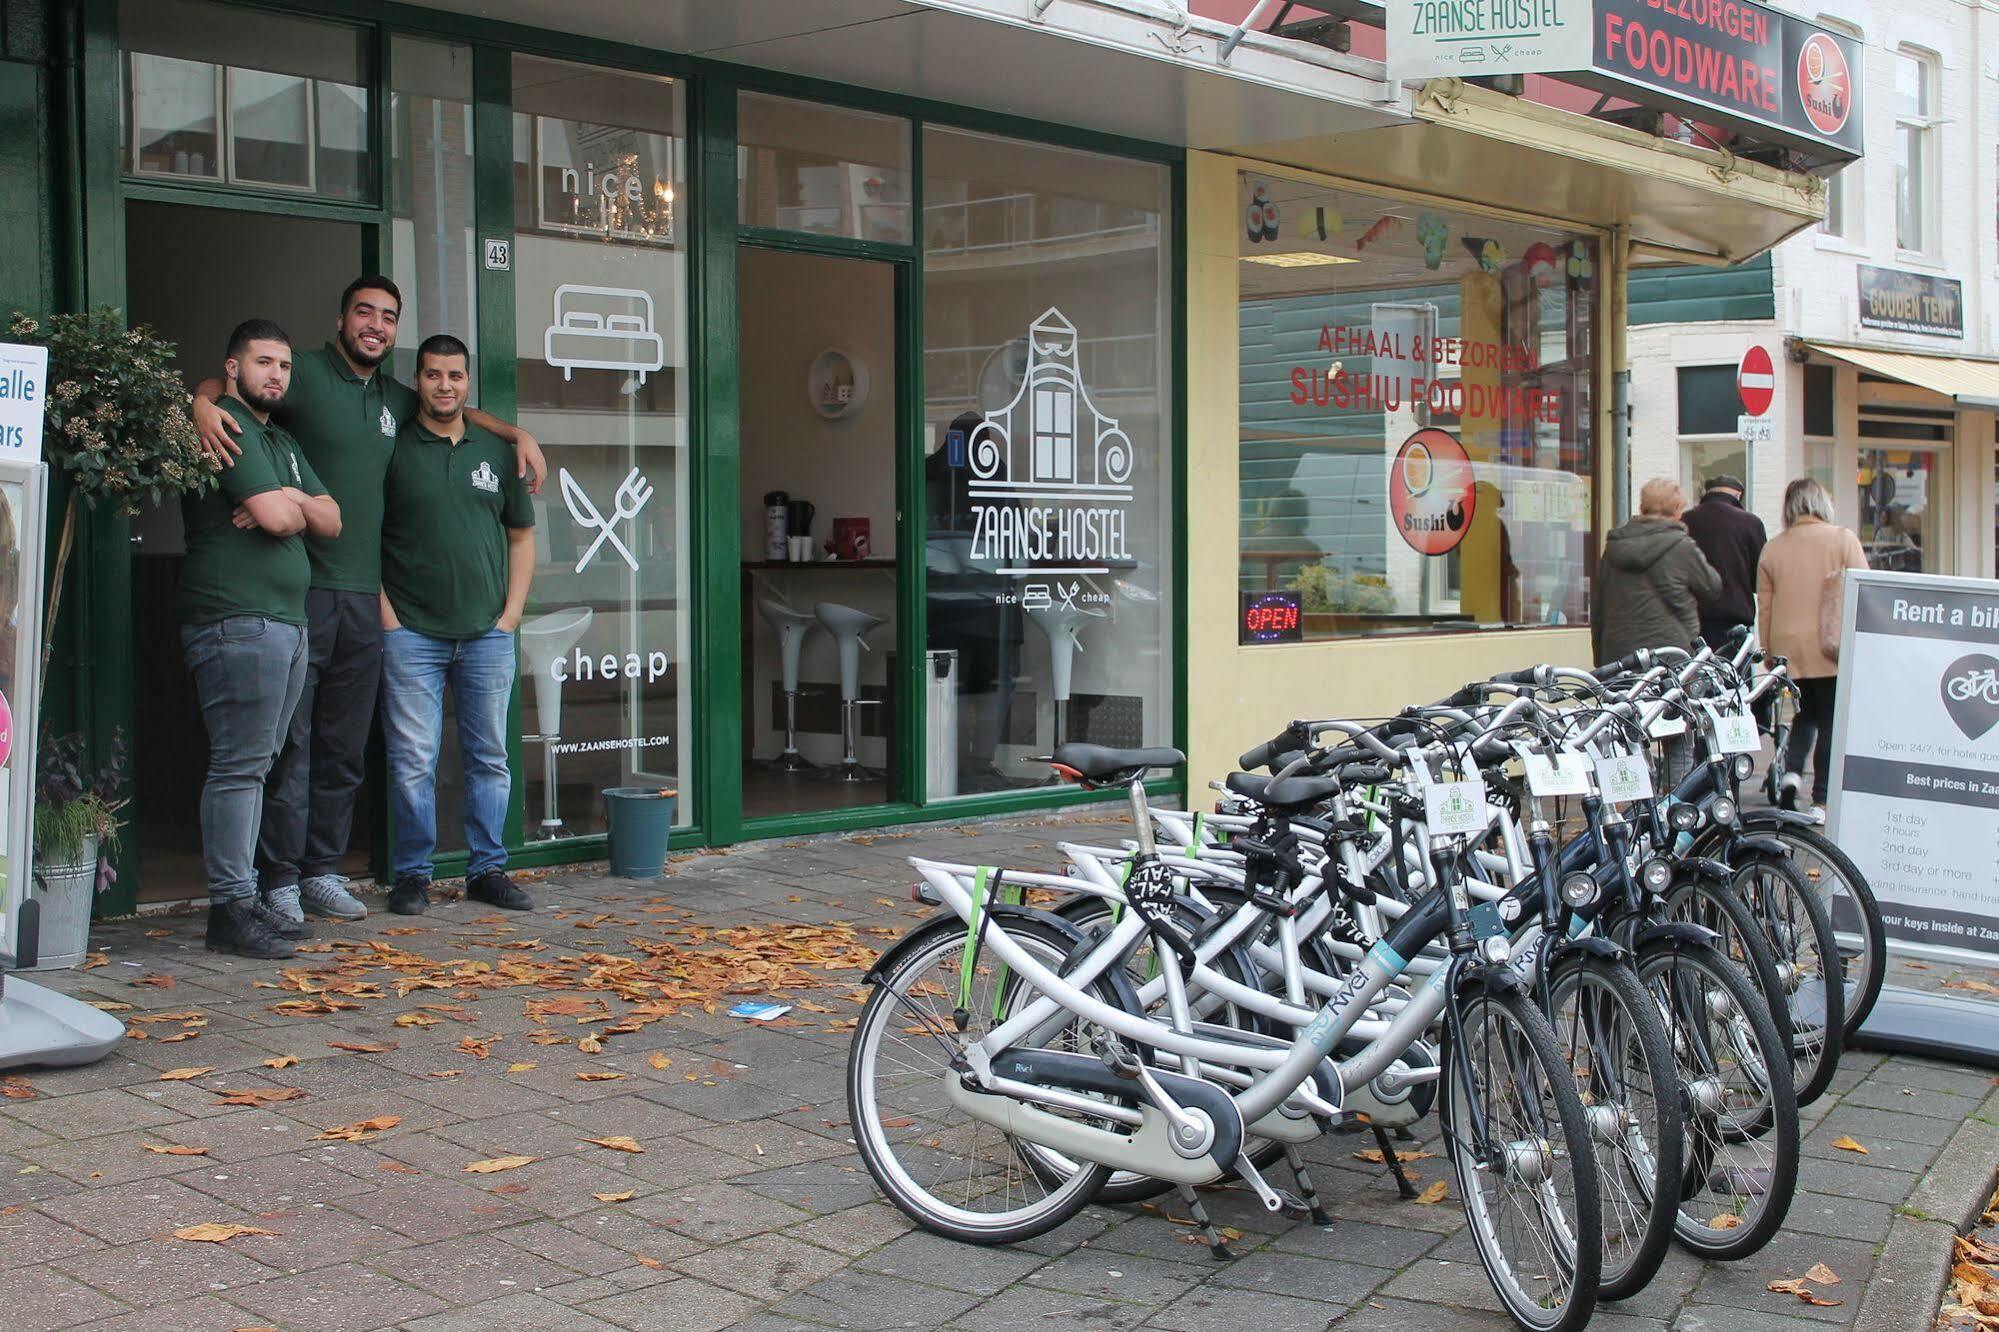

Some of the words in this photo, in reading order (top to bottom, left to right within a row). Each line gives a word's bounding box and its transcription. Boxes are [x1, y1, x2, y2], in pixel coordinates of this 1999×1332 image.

[1413, 0, 1485, 34] ZAANSE
[1492, 0, 1565, 29] HOSTEL
[1515, 49, 1542, 57] cheap
[1605, 13, 1778, 113] FOODWARE
[1807, 94, 1832, 115] Sushi
[562, 163, 642, 201] nice
[489, 246, 507, 265] 43
[1870, 288, 1920, 320] GOUDEN
[1922, 295, 1955, 325] TENT
[1318, 325, 1406, 361] AFHAAL
[1412, 335, 1426, 361] &
[1432, 337, 1540, 372] BEZORGEN
[1290, 366, 1400, 412] SUSHIU
[1411, 376, 1562, 424] FOODWARE
[970, 505, 1054, 560] ZAANSE
[1059, 508, 1132, 560] HOSTEL
[1404, 513, 1446, 532] Sushi
[995, 593, 1017, 604] nice
[1081, 593, 1111, 605] cheap
[1247, 607, 1298, 630] OPEN
[1892, 599, 1945, 624] Rent
[1950, 608, 1964, 627] a
[550, 647, 669, 683] cheap
[550, 735, 670, 754] WWW.ZAANSEHOSTEL.COM
[1878, 739, 1907, 753] Open:
[1906, 773, 1931, 786] Best
[1933, 777, 1966, 791] prices
[1968, 780, 1979, 792] in
[1887, 811, 1902, 822] 1st
[1906, 812, 1928, 827] day
[1883, 825, 1890, 835] 3
[1892, 826, 1919, 838] hours
[1882, 841, 1904, 854] 2nd
[1907, 844, 1928, 858] day
[1880, 859, 1900, 872] 3rd
[1903, 863, 1925, 877] day
[1927, 867, 1939, 877] or
[1942, 869, 1972, 881] more
[1904, 916, 1930, 931] keys
[1931, 920, 1964, 934] inside
[1966, 926, 1978, 937] at
